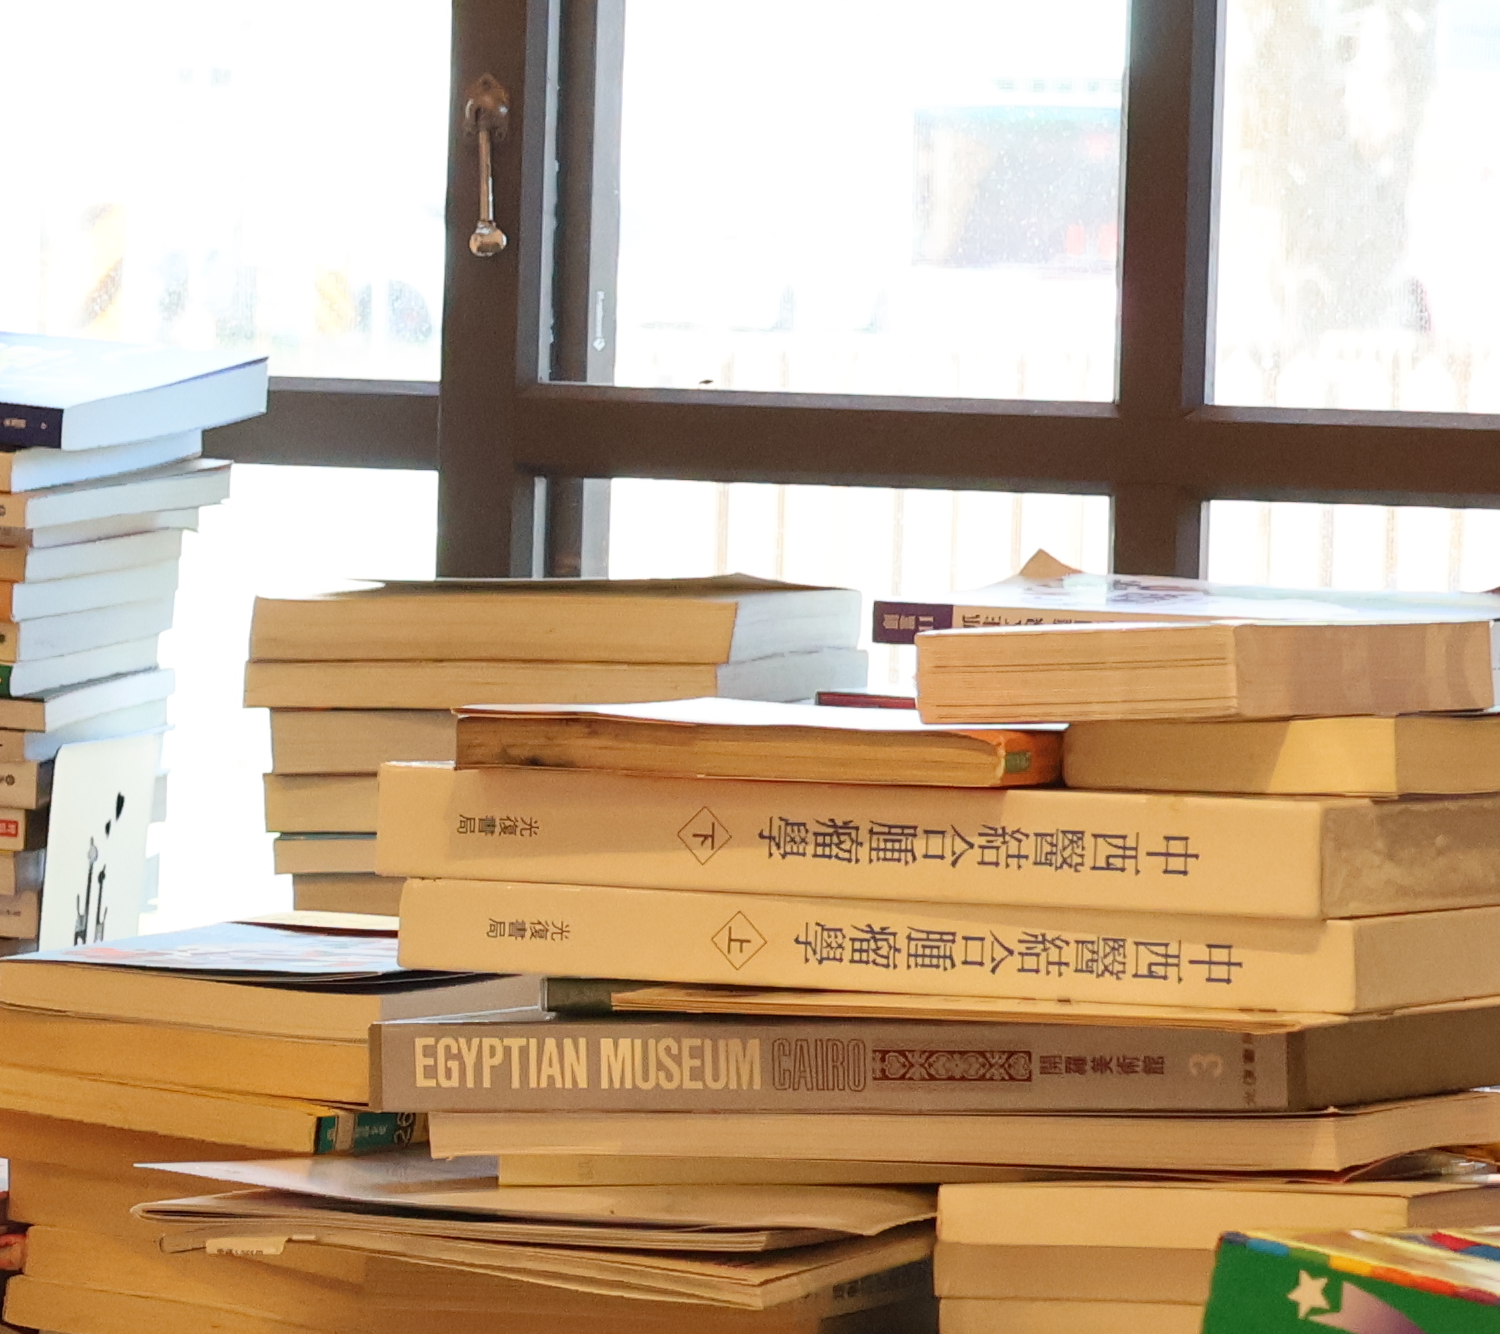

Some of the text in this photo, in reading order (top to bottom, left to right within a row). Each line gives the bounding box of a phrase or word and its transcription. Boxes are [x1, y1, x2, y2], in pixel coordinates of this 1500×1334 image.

[454, 814, 541, 838] 光復書局
[758, 816, 1199, 878] 中西醫結合腫瘤學
[484, 917, 571, 942] 光復書局
[795, 921, 1243, 985] 中西醫結合腫瘤學
[414, 1037, 589, 1089] EGYPTIAN
[600, 1037, 761, 1090] MUSEUM
[771, 1037, 867, 1092] CAIRO
[1038, 1053, 1165, 1076] 開羅美術館
